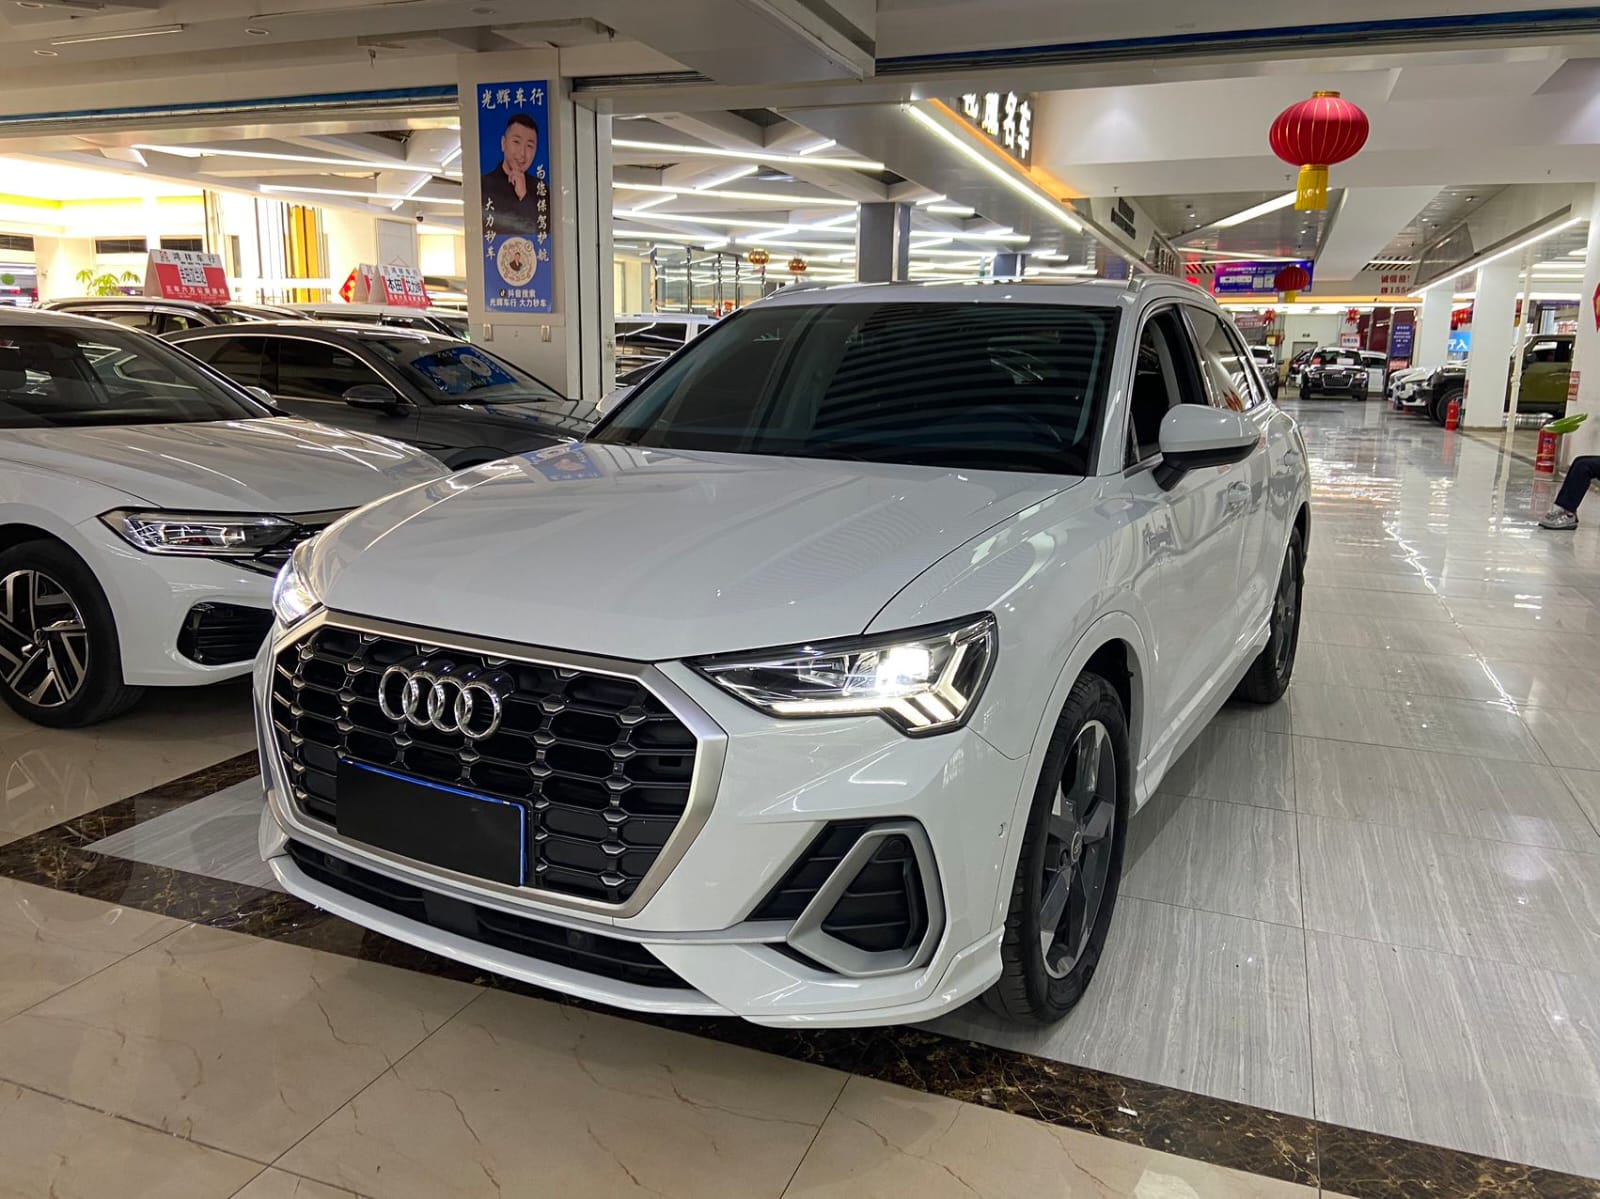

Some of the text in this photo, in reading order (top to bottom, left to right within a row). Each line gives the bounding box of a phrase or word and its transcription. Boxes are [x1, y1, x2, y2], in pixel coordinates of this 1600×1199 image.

[481, 87, 544, 109] 光辉车行
[536, 164, 549, 262] 为您保驾护航
